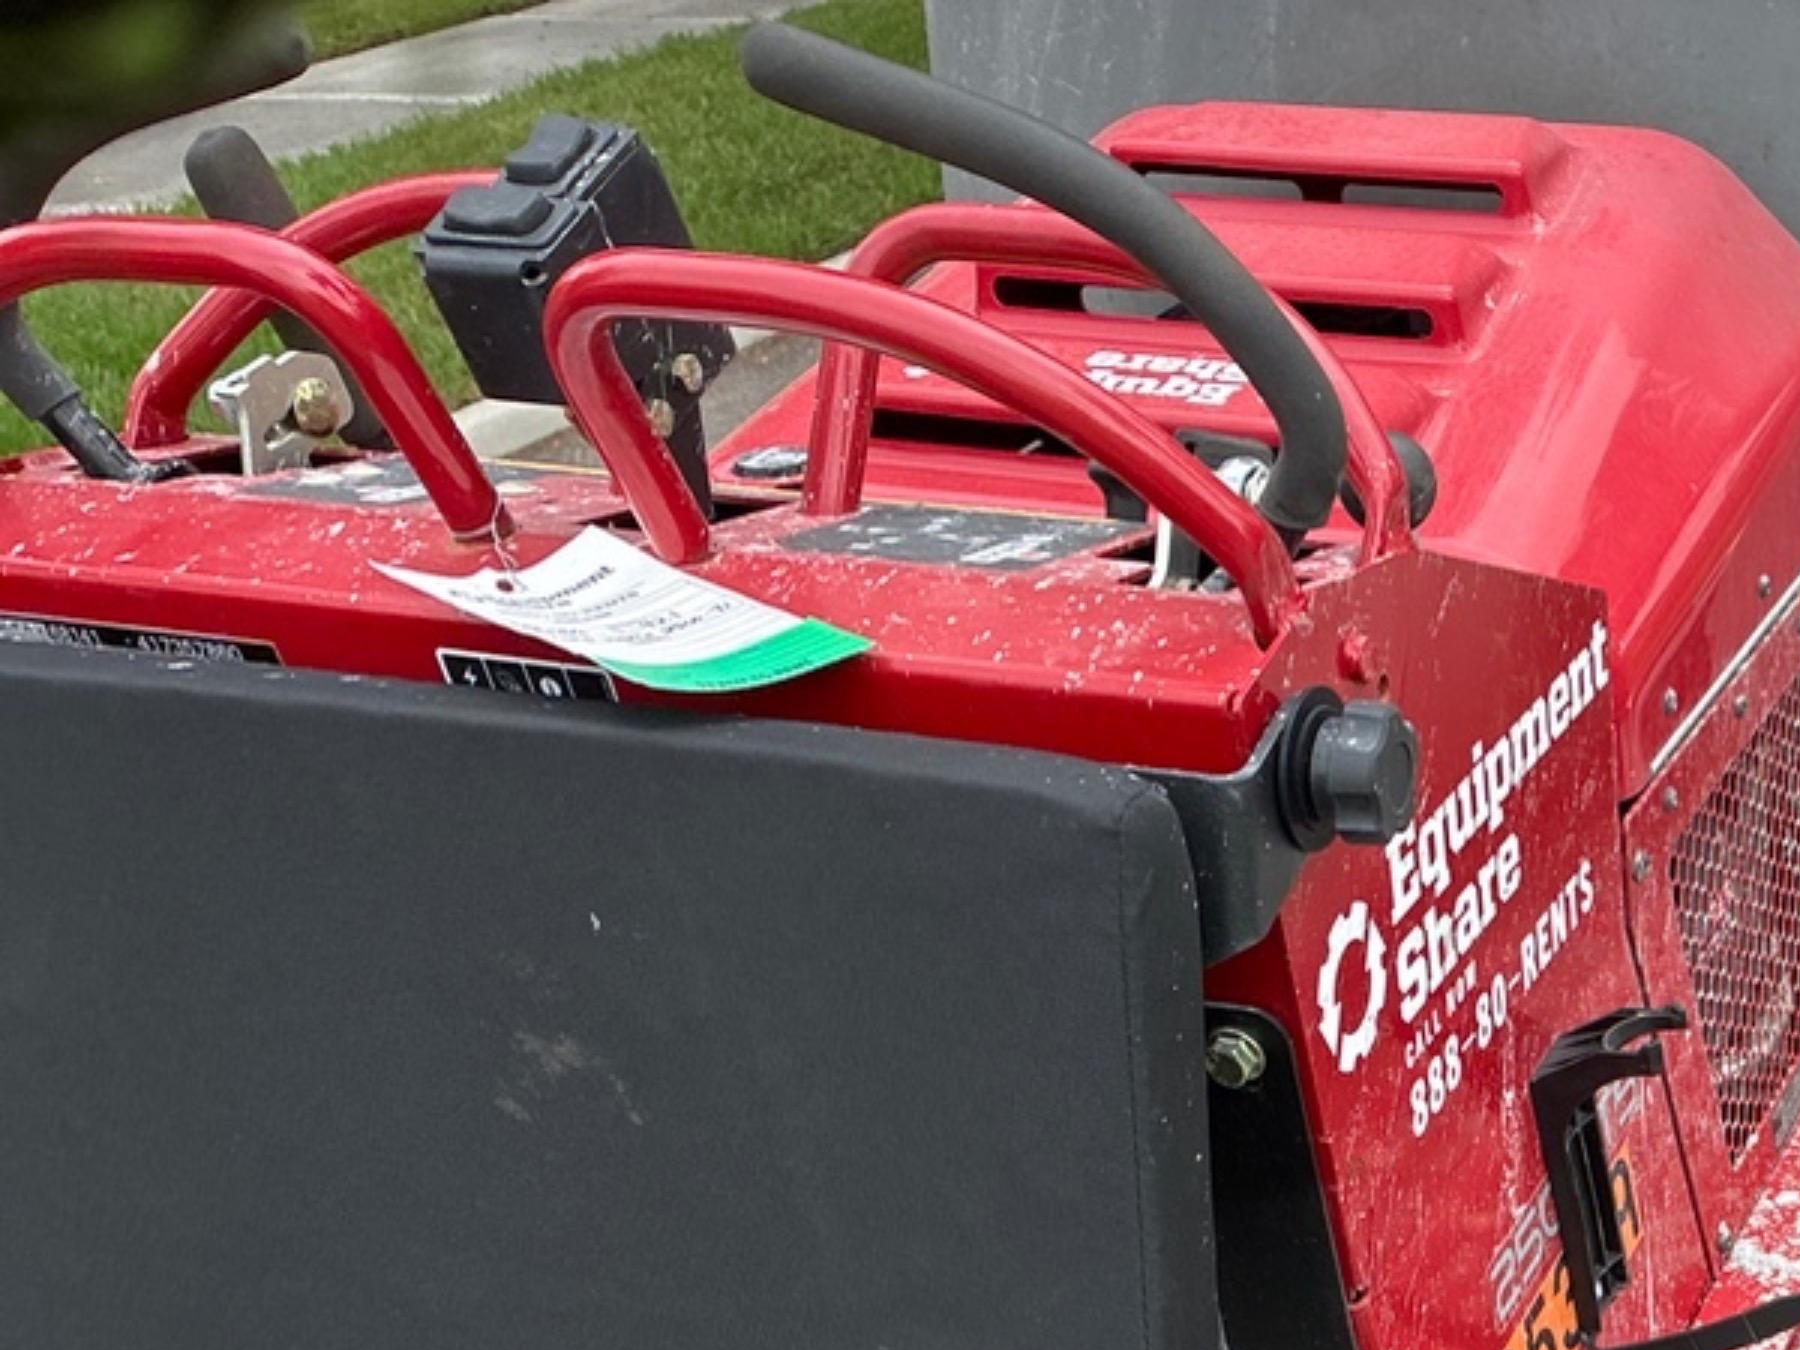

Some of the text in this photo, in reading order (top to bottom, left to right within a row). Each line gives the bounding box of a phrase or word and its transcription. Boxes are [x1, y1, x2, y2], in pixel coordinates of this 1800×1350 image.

[1385, 618, 1609, 925] Equipment
[1396, 834, 1522, 1023] Share
[1410, 857, 1595, 1138] 888-80-RENTS
